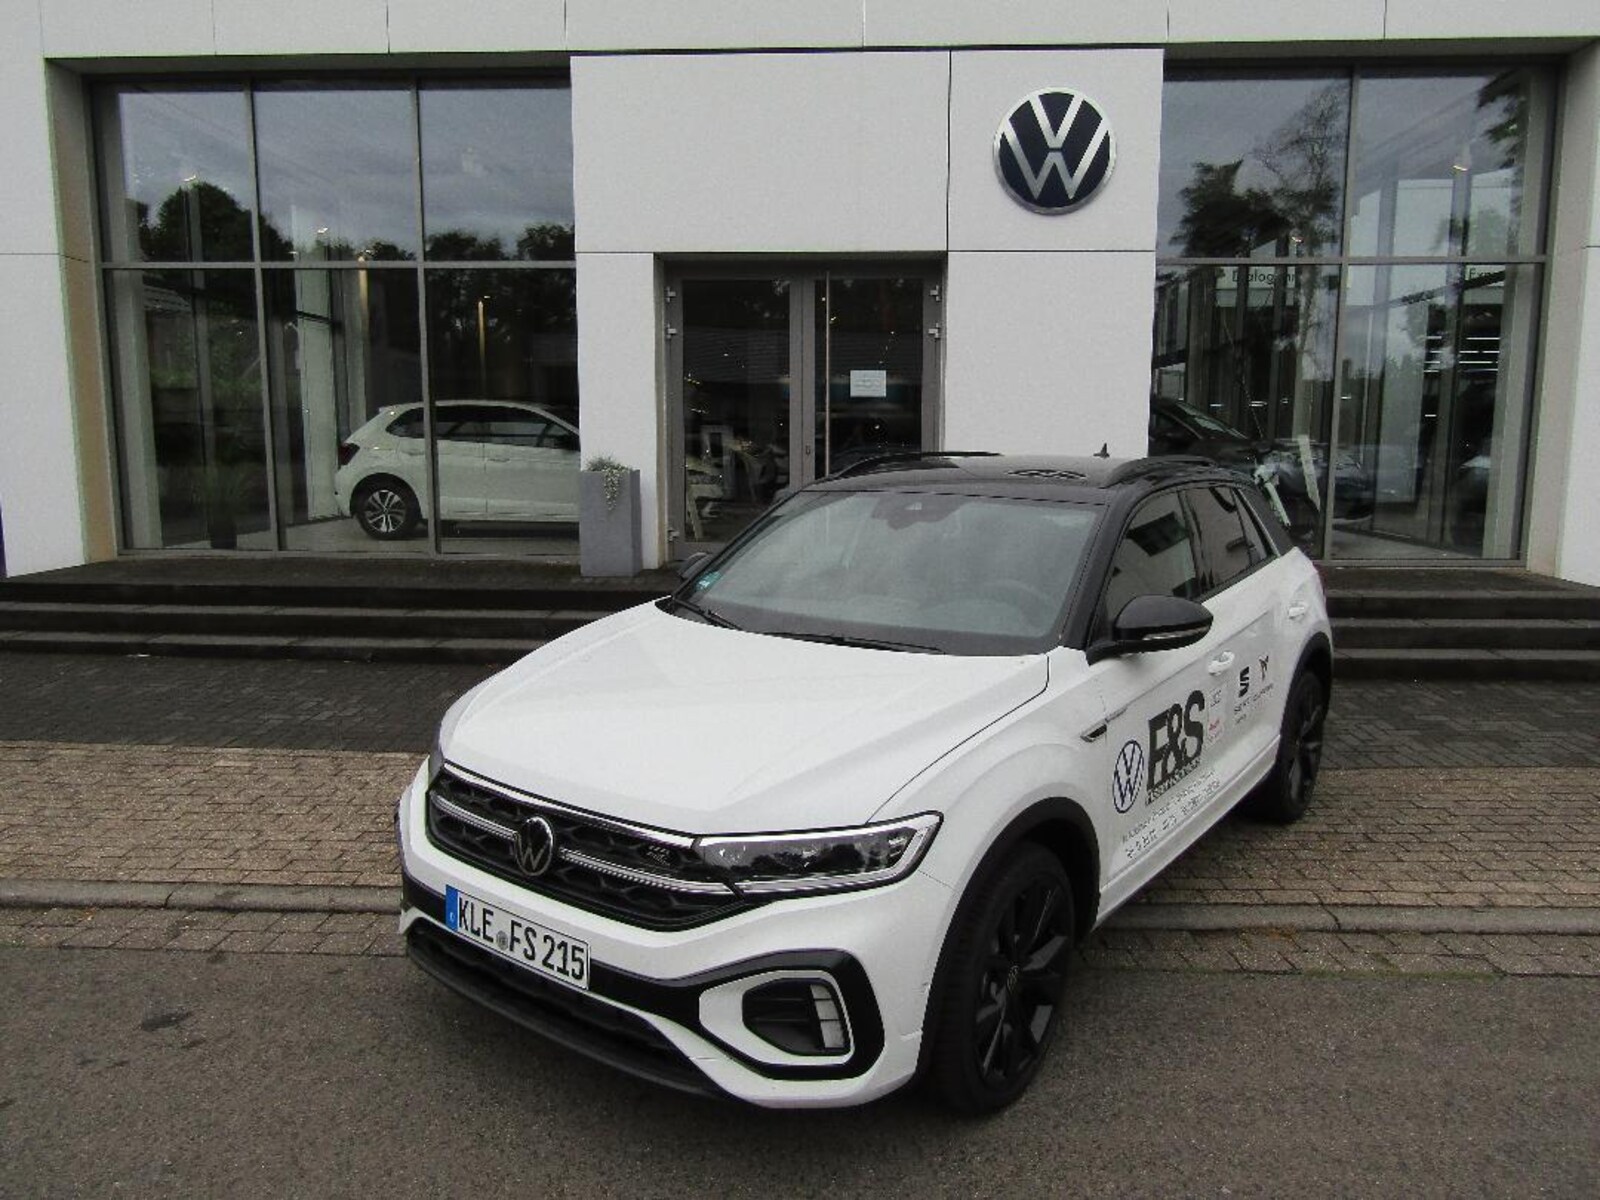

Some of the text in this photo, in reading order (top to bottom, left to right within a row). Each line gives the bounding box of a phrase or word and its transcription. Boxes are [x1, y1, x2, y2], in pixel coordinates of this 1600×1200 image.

[995, 88, 1116, 213] VW
[459, 897, 585, 981] KLE FS 215
